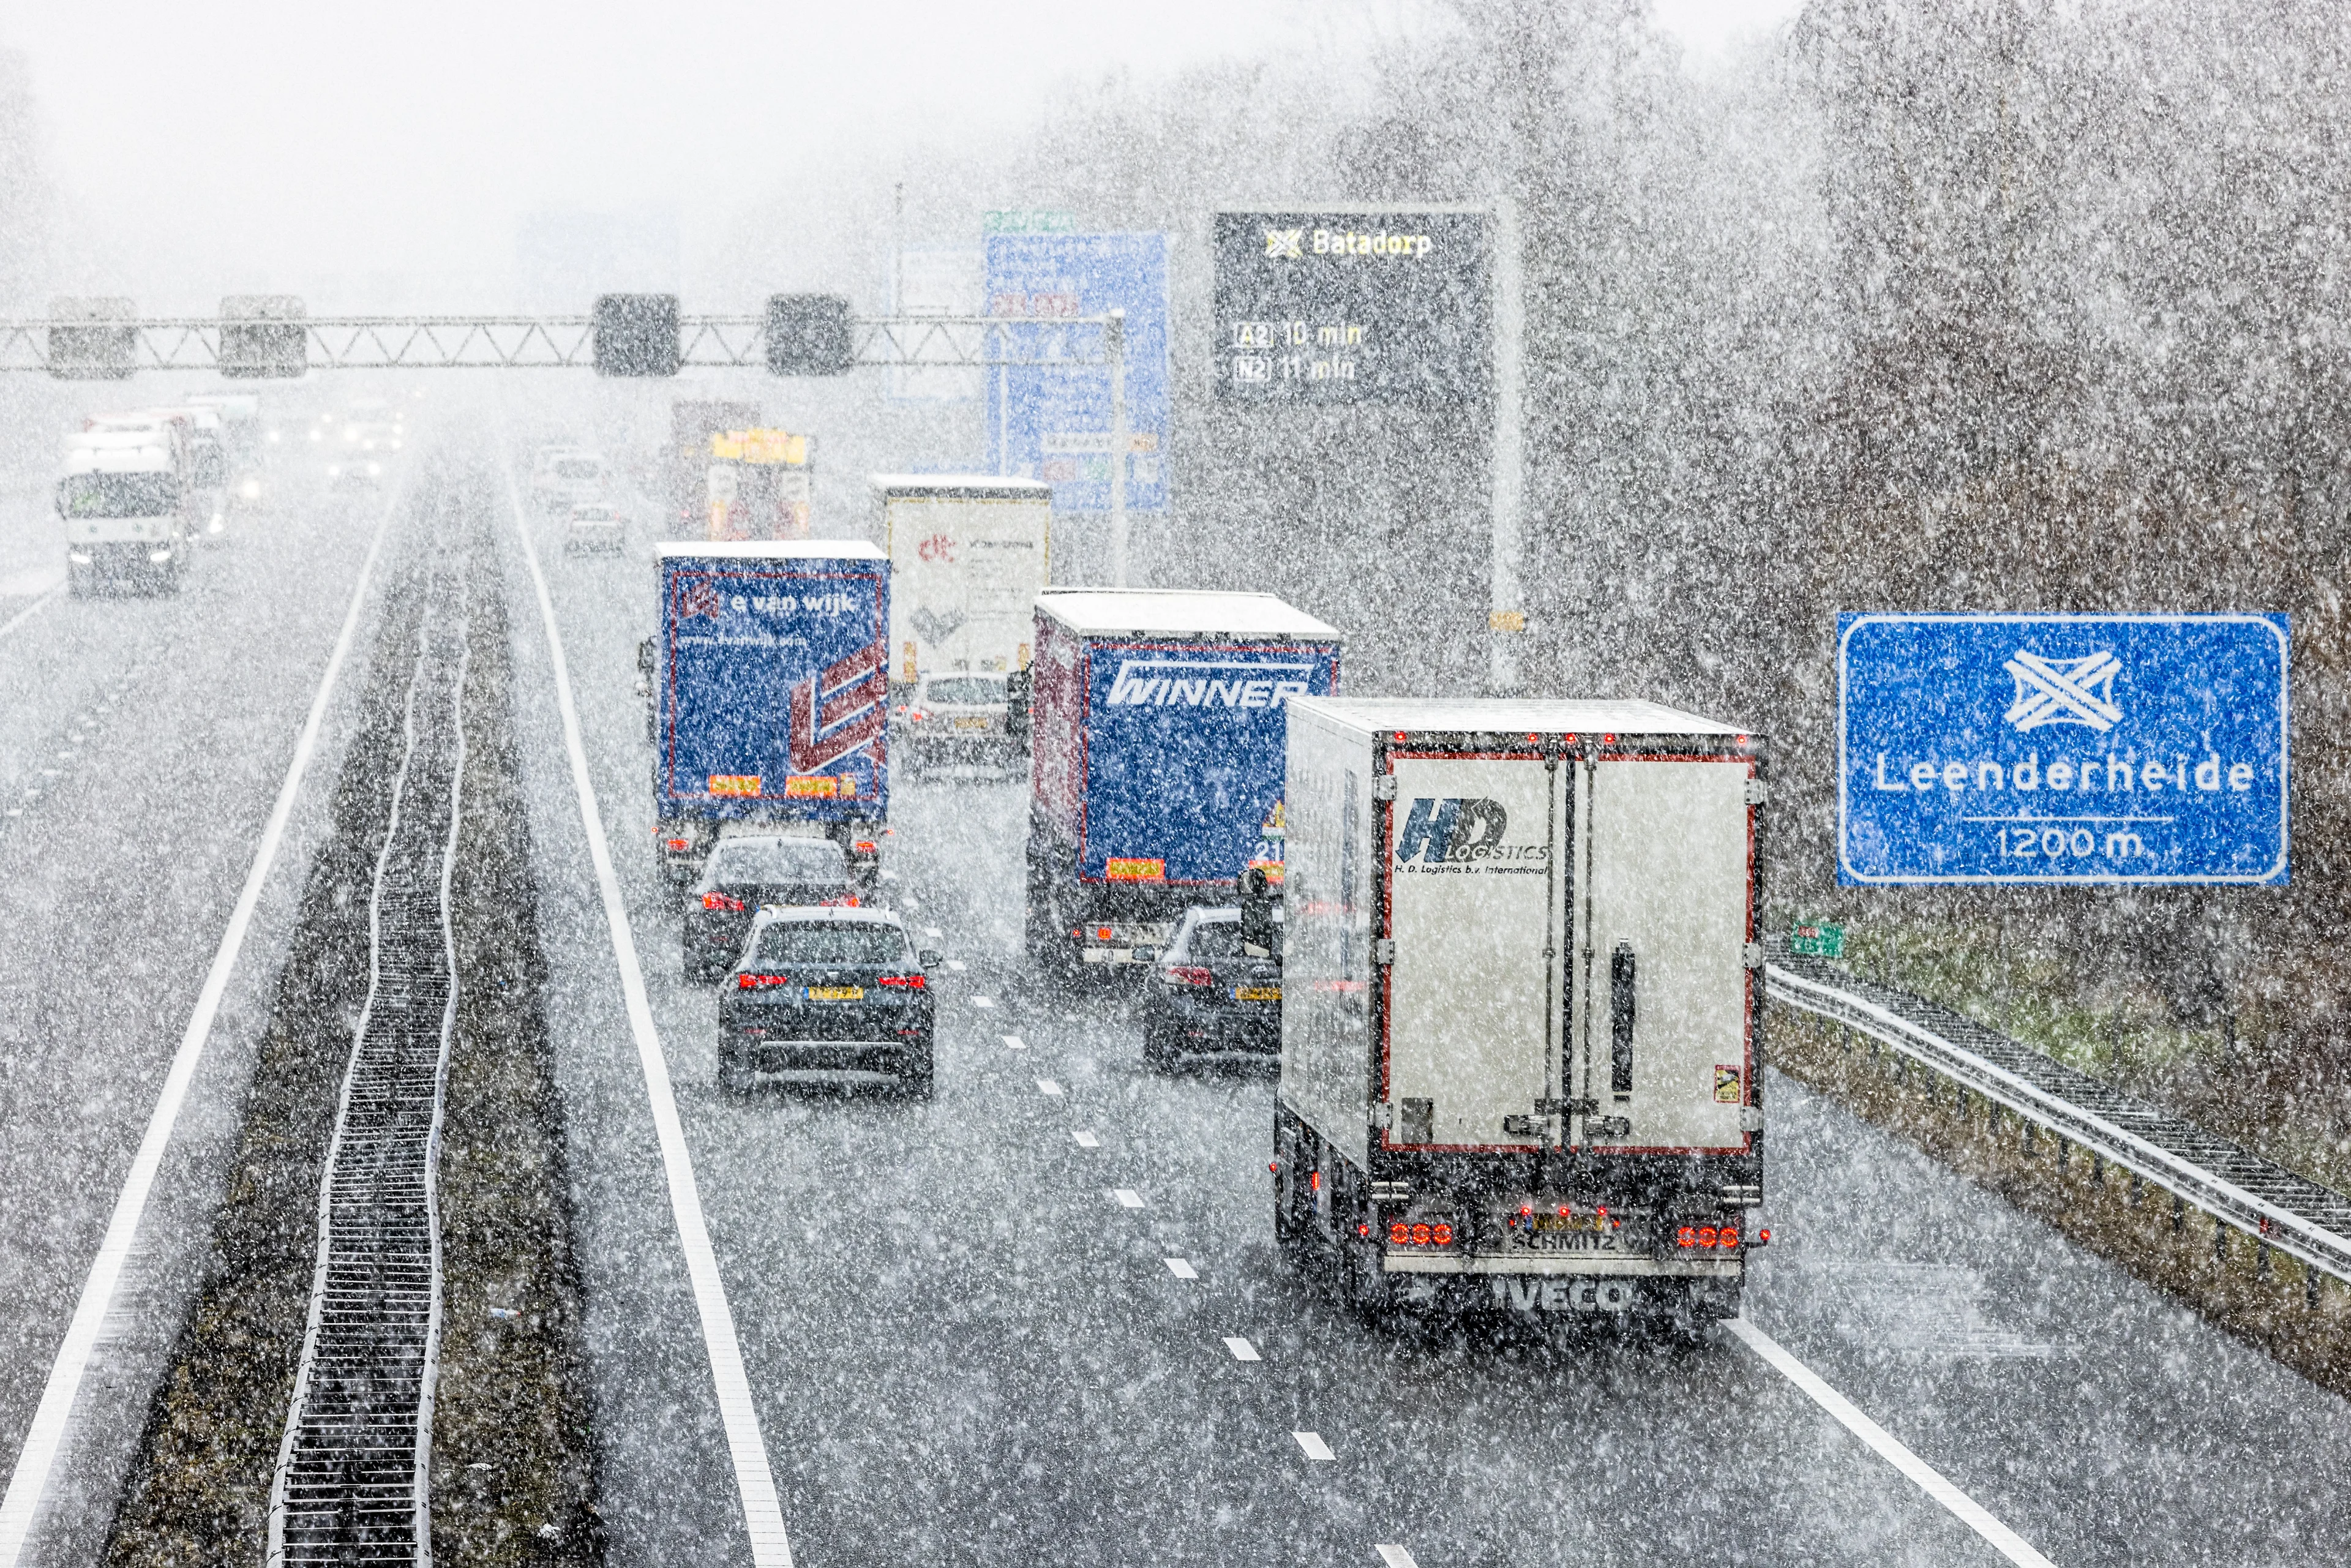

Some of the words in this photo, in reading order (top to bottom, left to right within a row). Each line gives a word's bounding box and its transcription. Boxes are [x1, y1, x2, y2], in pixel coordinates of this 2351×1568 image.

[1313, 230, 1431, 258] Batadorp
[1240, 324, 1270, 346] A2
[1283, 321, 1307, 346] 10
[1318, 321, 1362, 346] min
[1238, 358, 1267, 379] N2
[1278, 354, 1300, 380] 11
[1311, 353, 1355, 380] min
[730, 595, 746, 612] e
[752, 596, 797, 612] van
[802, 592, 857, 618] wijk
[1875, 752, 2254, 791] Leenderheide
[1396, 797, 1507, 864] HD
[1999, 828, 2096, 857] 1200
[2107, 832, 2143, 857] m
[1444, 846, 1551, 860] LOGISTICS
[1421, 865, 1462, 875] Logistics
[1485, 866, 1548, 875] International
[1512, 1232, 1616, 1250] SCHMITZ
[1493, 1278, 1633, 1311] IVECO
